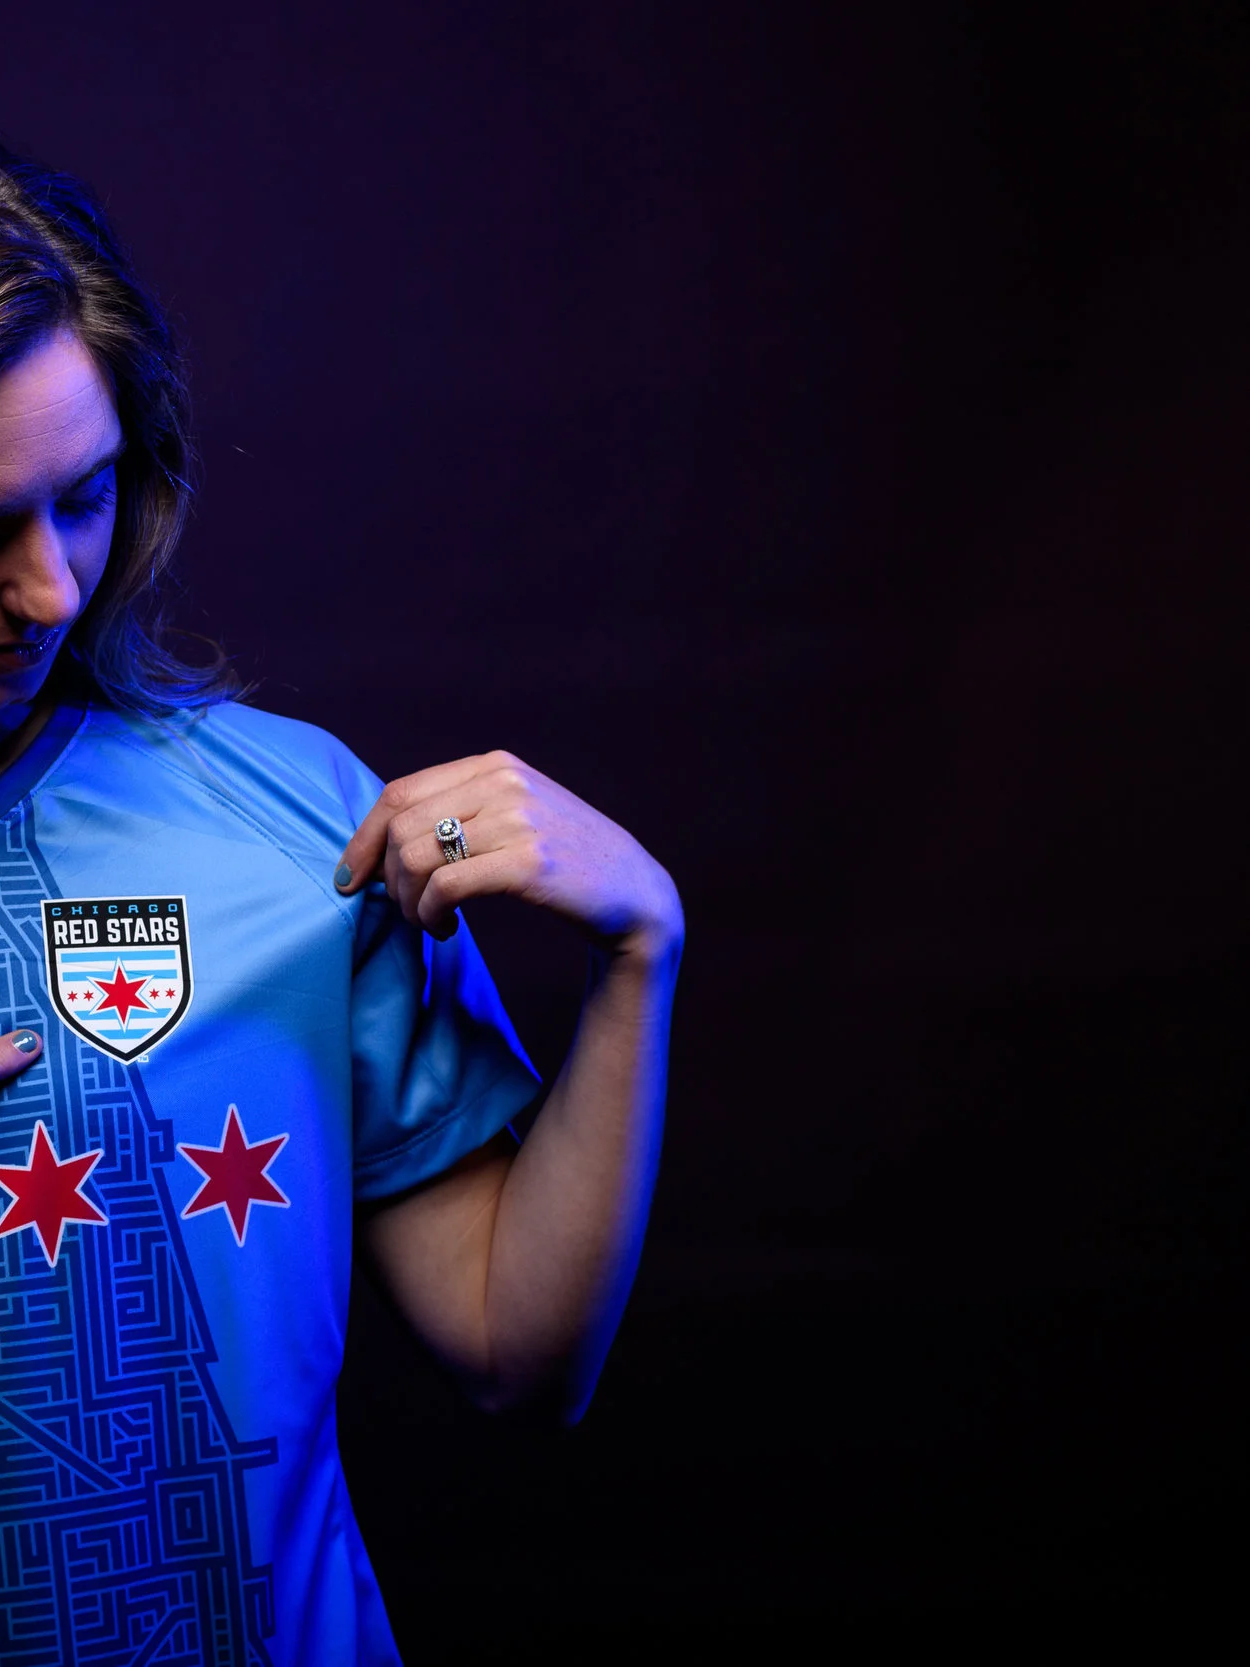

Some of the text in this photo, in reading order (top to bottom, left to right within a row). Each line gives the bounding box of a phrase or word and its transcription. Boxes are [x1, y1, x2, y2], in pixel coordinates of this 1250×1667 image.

[51, 903, 178, 917] CHICAGO
[53, 917, 180, 945] RED STARS
